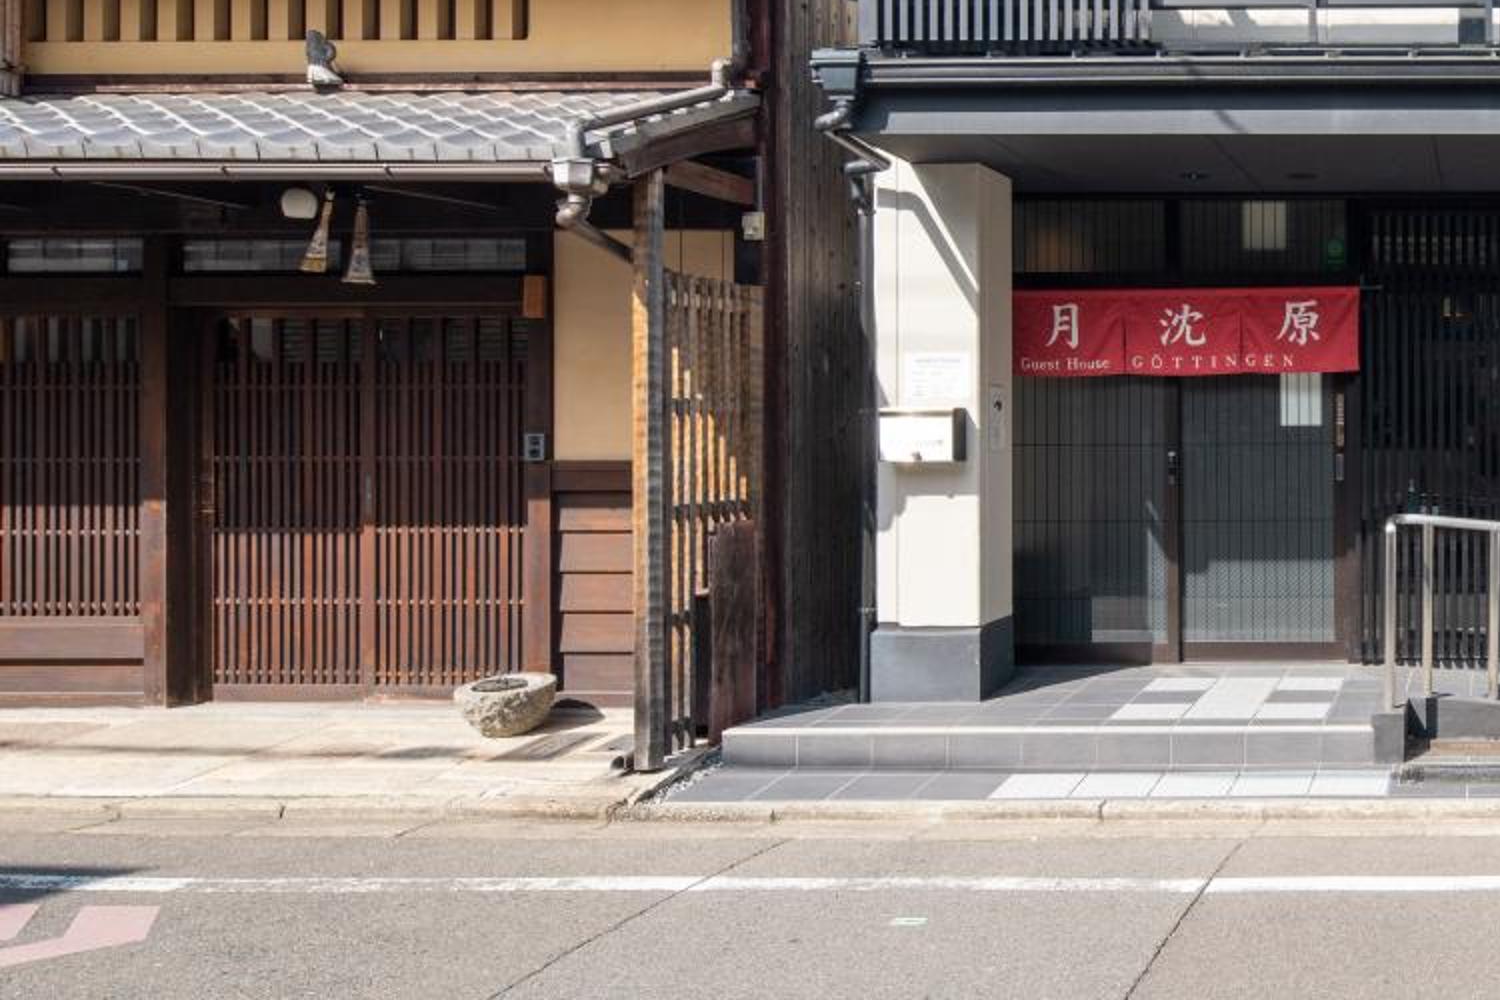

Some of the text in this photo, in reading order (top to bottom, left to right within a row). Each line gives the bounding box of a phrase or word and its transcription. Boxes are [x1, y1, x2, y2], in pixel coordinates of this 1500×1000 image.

[1045, 299, 1321, 349] 月沈原
[1021, 357, 1111, 370] Guest House
[1131, 353, 1294, 370] GÖTTINGEN
